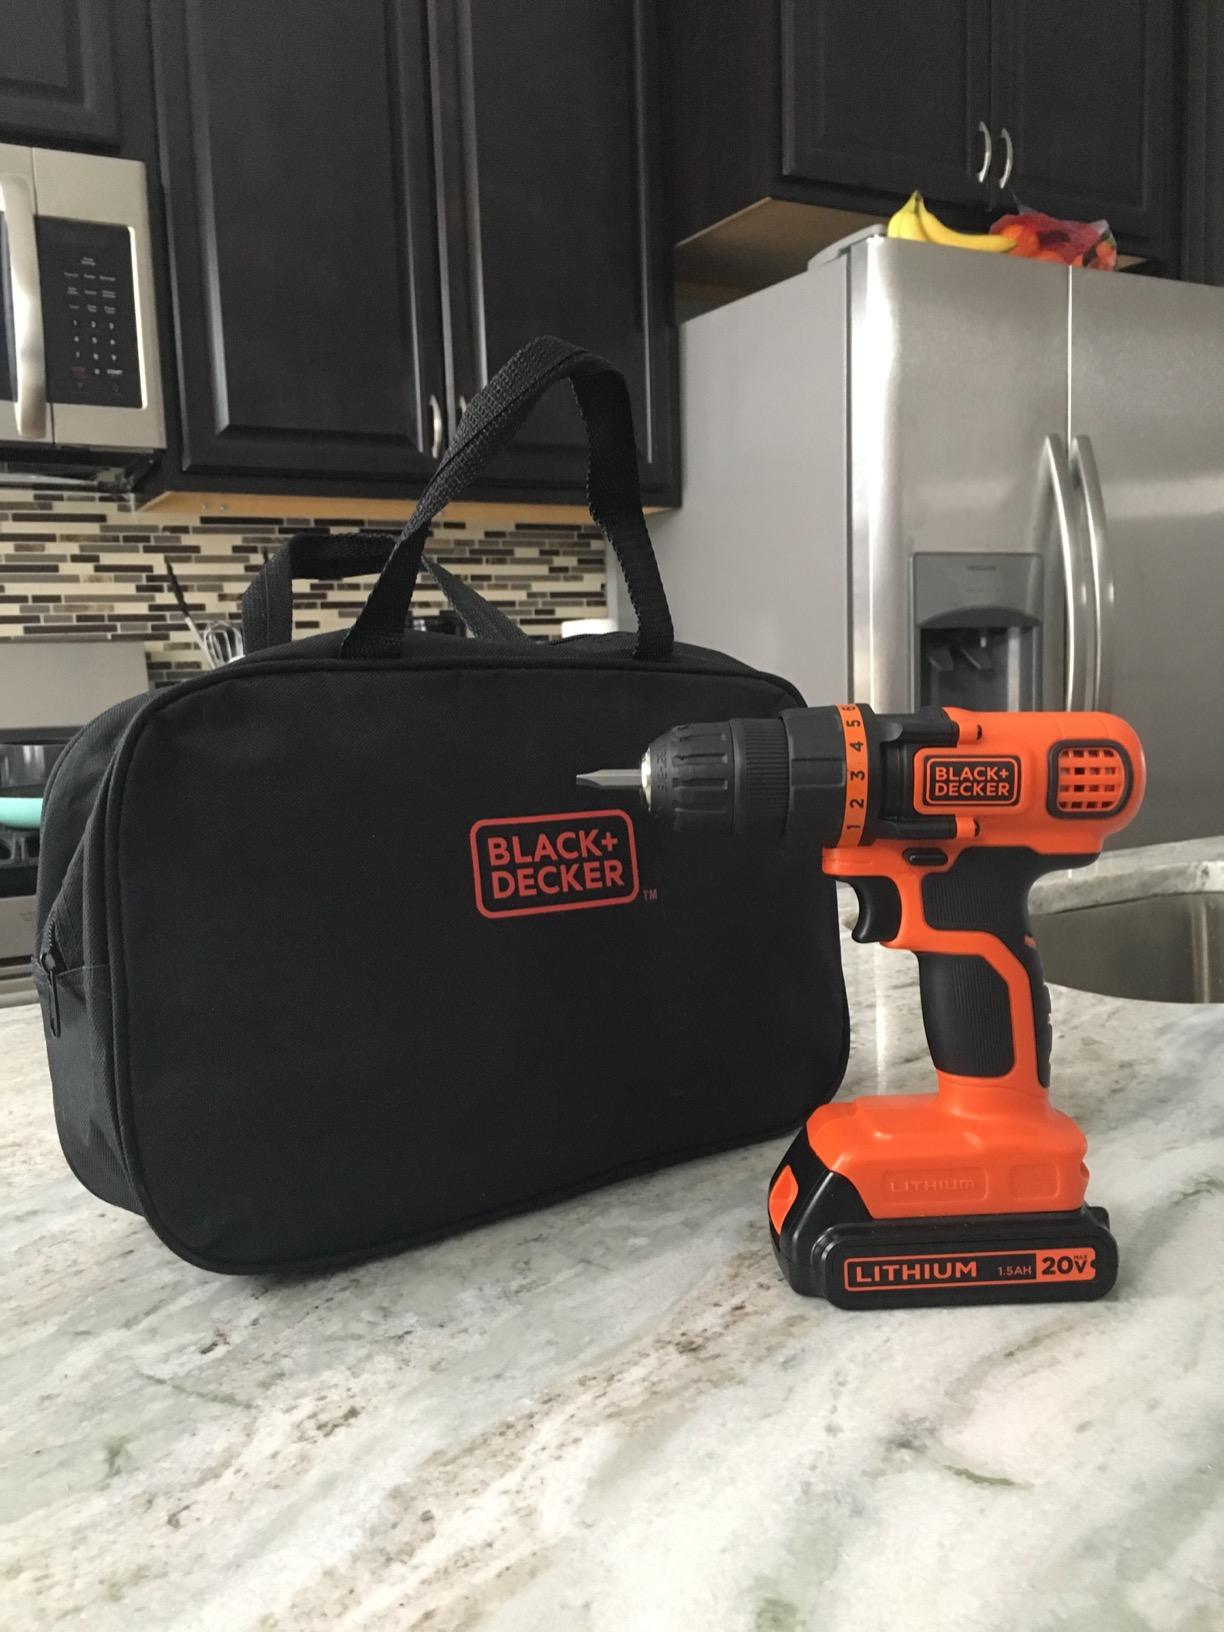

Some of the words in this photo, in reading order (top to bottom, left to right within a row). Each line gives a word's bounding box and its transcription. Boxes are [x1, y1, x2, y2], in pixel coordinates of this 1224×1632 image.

[846, 719, 861, 728] 5
[849, 741, 864, 752] 4
[850, 770, 865, 781] 3
[935, 766, 1009, 781] BLACK+
[935, 782, 1009, 797] DECKER
[849, 798, 865, 809] 2
[487, 829, 618, 866] BLACK+
[491, 859, 625, 900] DECKER
[888, 1179, 976, 1194] LITHIUM
[856, 1260, 978, 1283] LITHIUM
[998, 1265, 1032, 1277] 1.5AH
[1041, 1256, 1088, 1275] 20V
